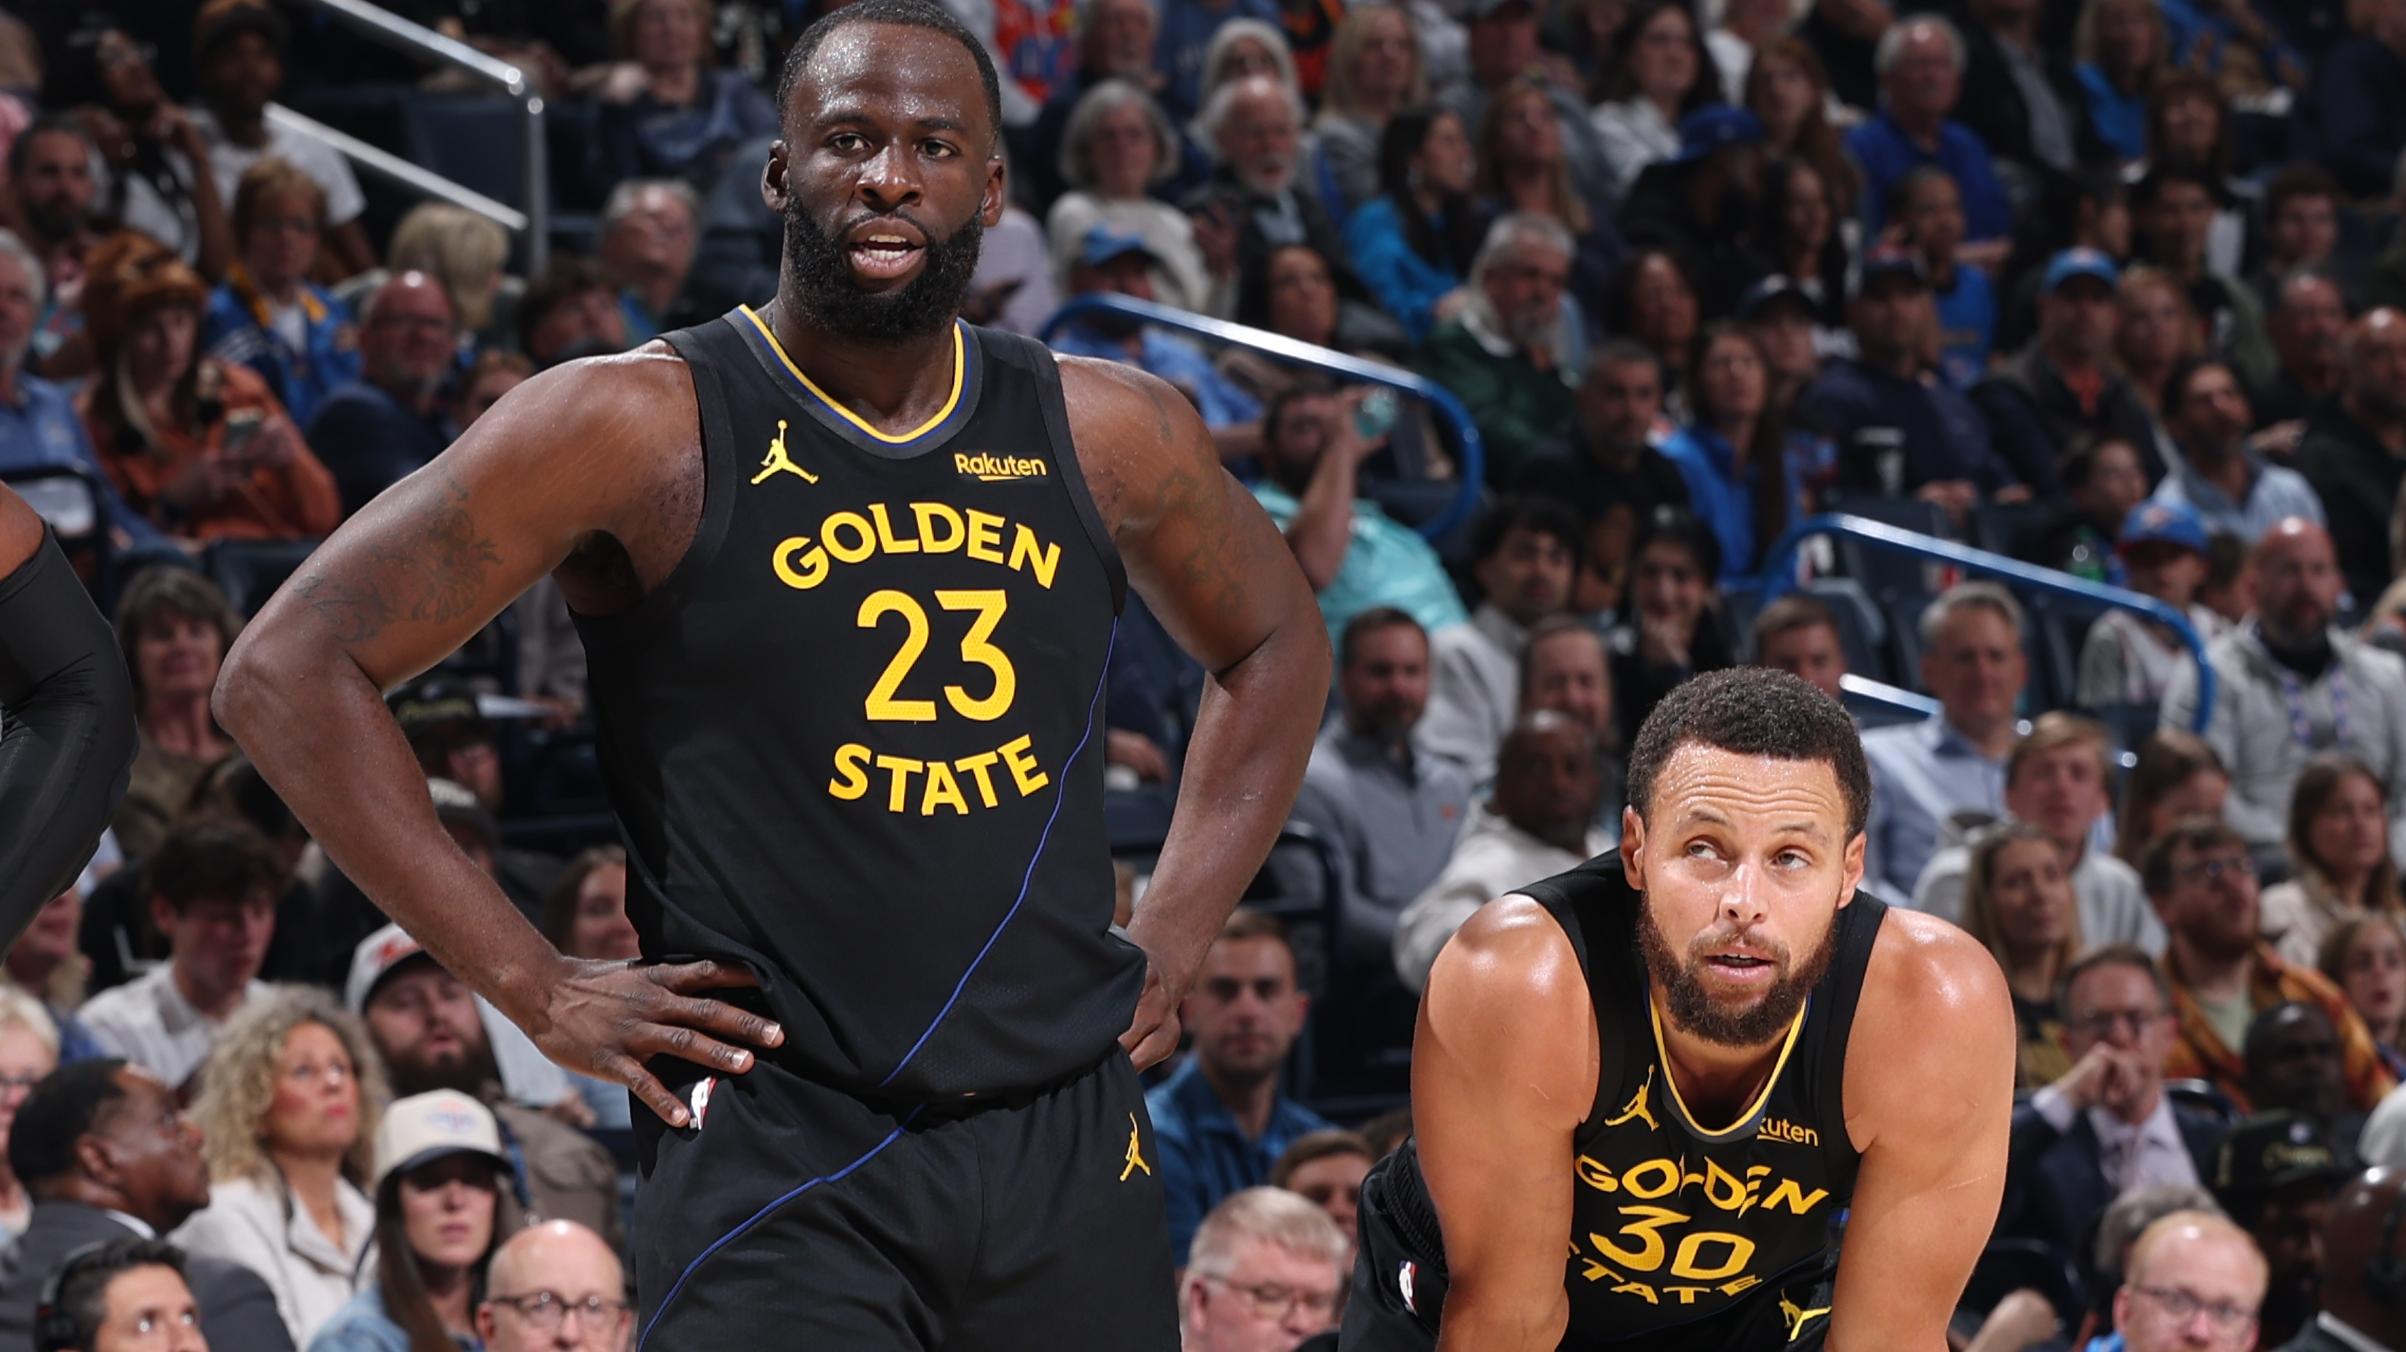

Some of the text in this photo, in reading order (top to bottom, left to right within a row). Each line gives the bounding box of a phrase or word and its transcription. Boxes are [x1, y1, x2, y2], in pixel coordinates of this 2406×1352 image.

[954, 452, 1047, 476] Rakuten
[772, 502, 1062, 590] GOLDEN
[856, 589, 1017, 722] 23
[828, 734, 1050, 817] STATE
[1760, 1117, 1819, 1147] uten
[1574, 1152, 1830, 1219] GOLDEN
[1569, 1240, 1763, 1305] TATE
[1589, 1204, 1756, 1280] 30
